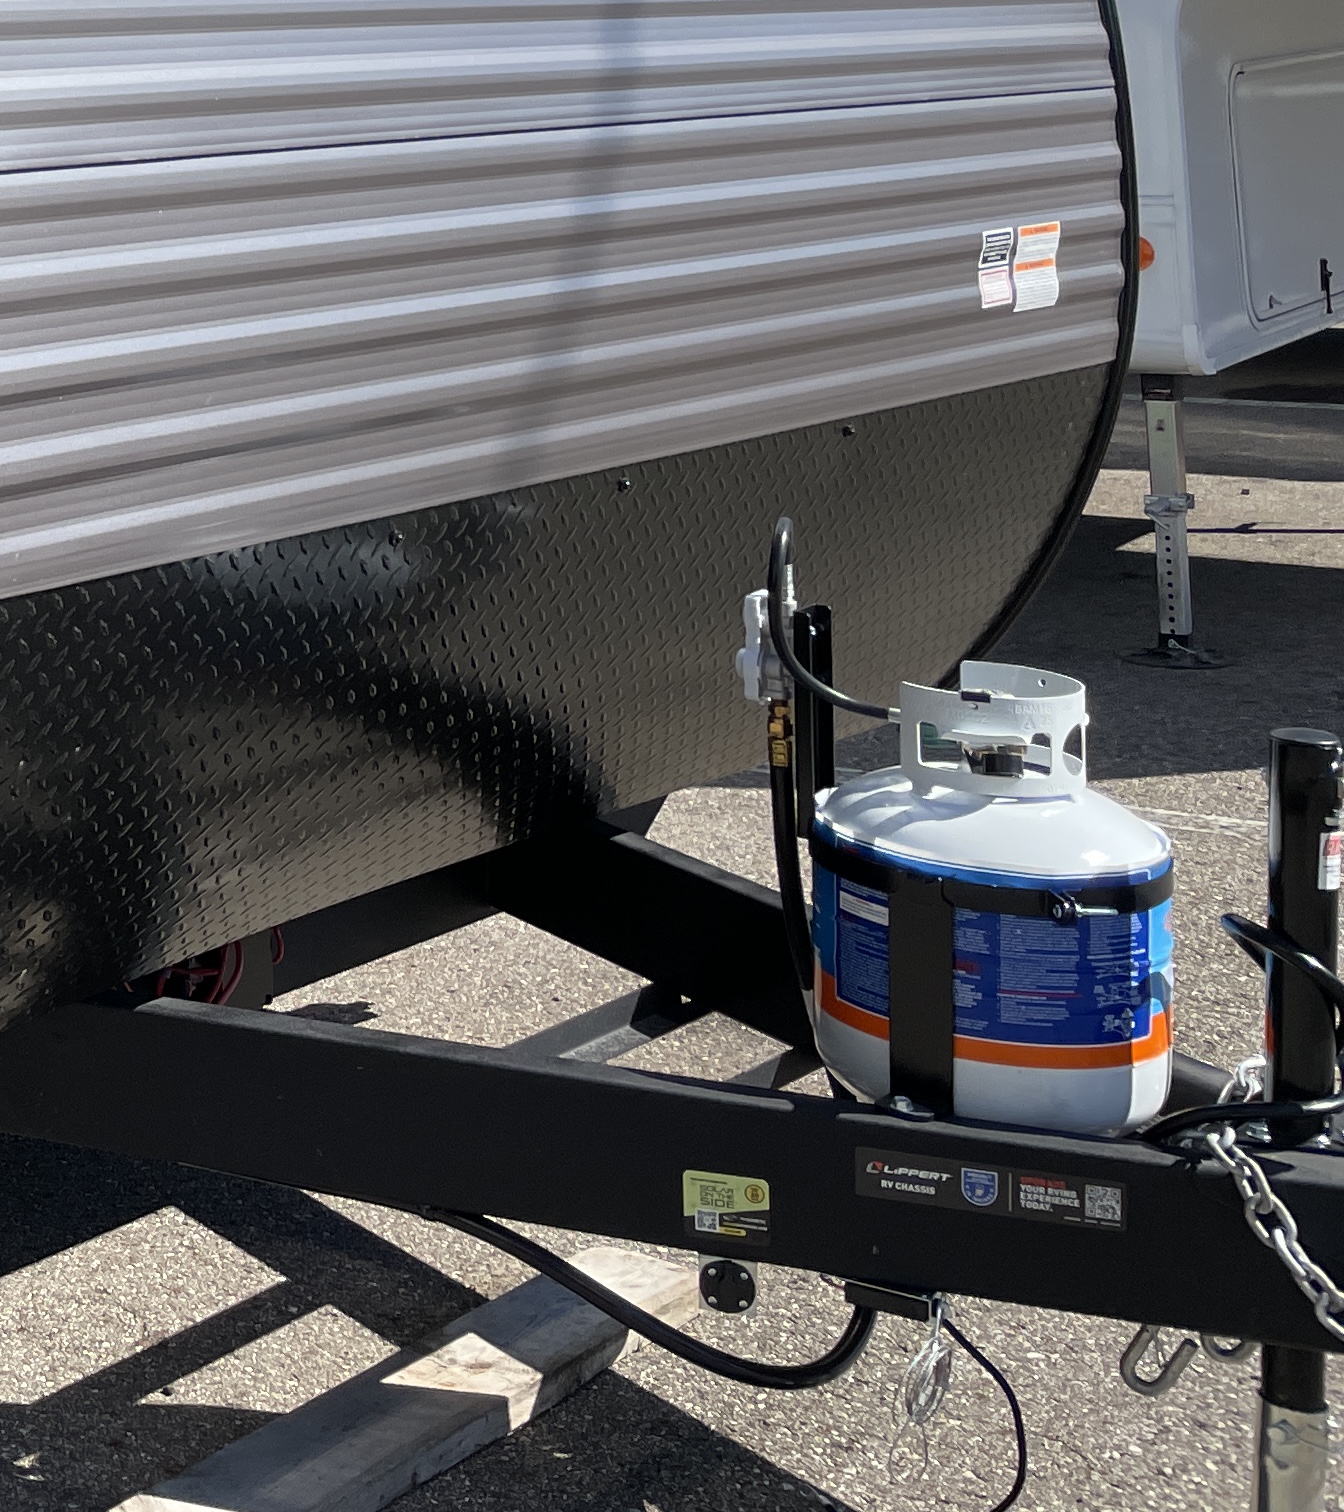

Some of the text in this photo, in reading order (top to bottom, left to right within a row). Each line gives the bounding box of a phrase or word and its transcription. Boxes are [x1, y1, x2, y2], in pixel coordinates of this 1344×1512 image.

[880, 1180, 936, 1195] RV CHASSIS
[1019, 1184, 1046, 1195] YOUR
[700, 1197, 735, 1209] SIDE
[1019, 1191, 1081, 1207] EXPERIENCE
[1020, 1200, 1054, 1212] TODAY.
